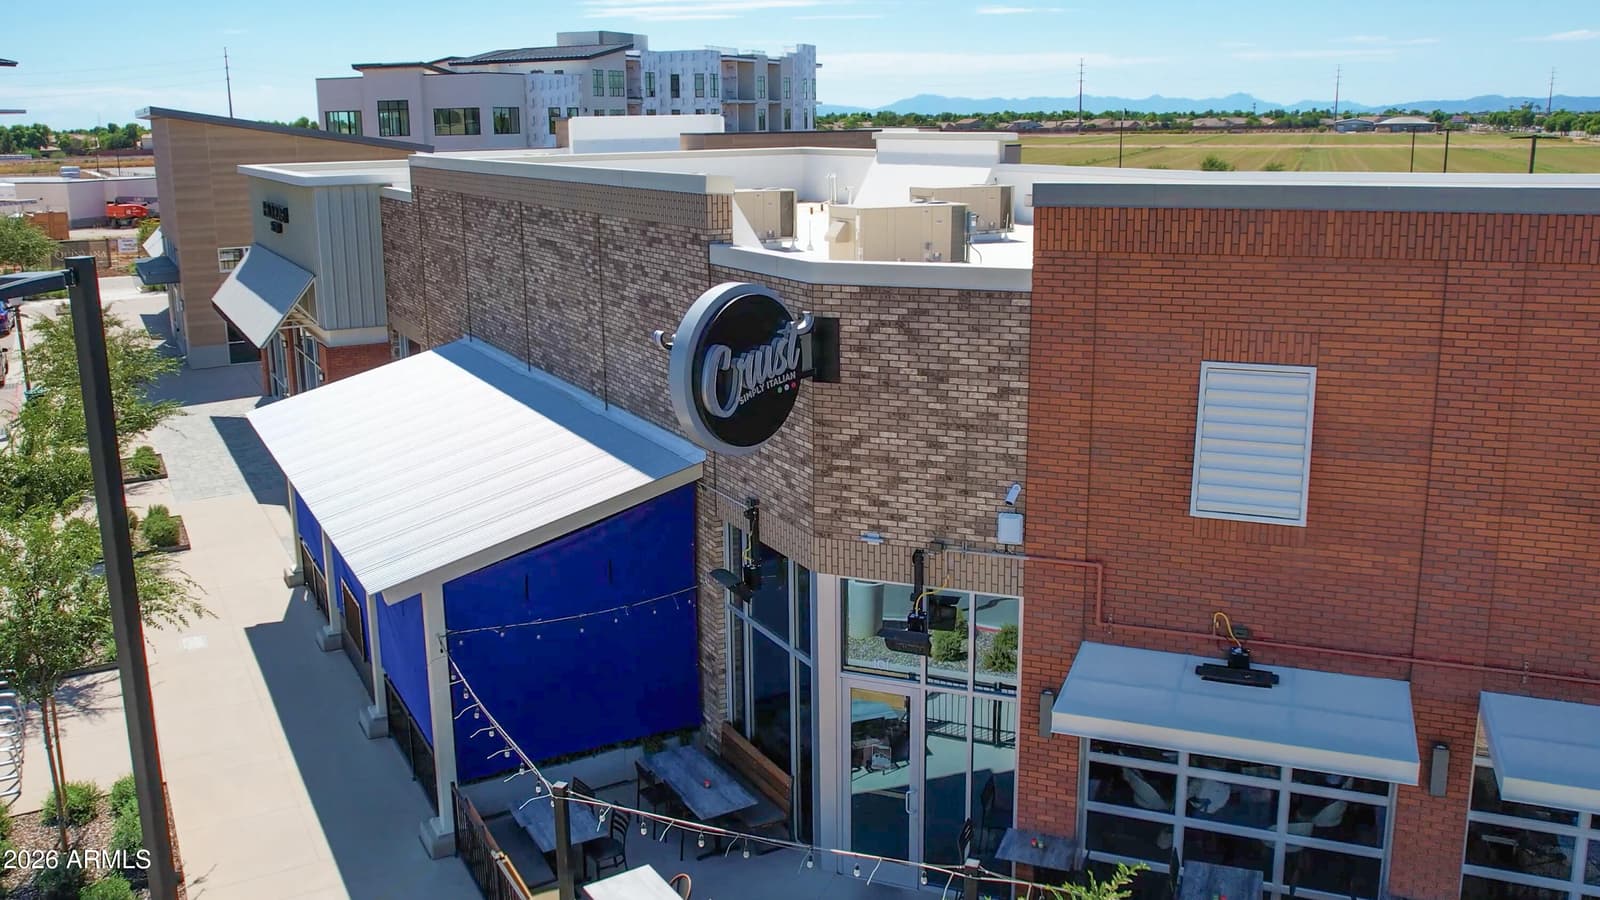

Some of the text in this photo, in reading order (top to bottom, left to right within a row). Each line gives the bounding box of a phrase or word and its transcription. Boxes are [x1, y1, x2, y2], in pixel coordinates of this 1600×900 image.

[703, 311, 814, 418] Crust
[740, 371, 796, 405] SIMPLY ITALIAN
